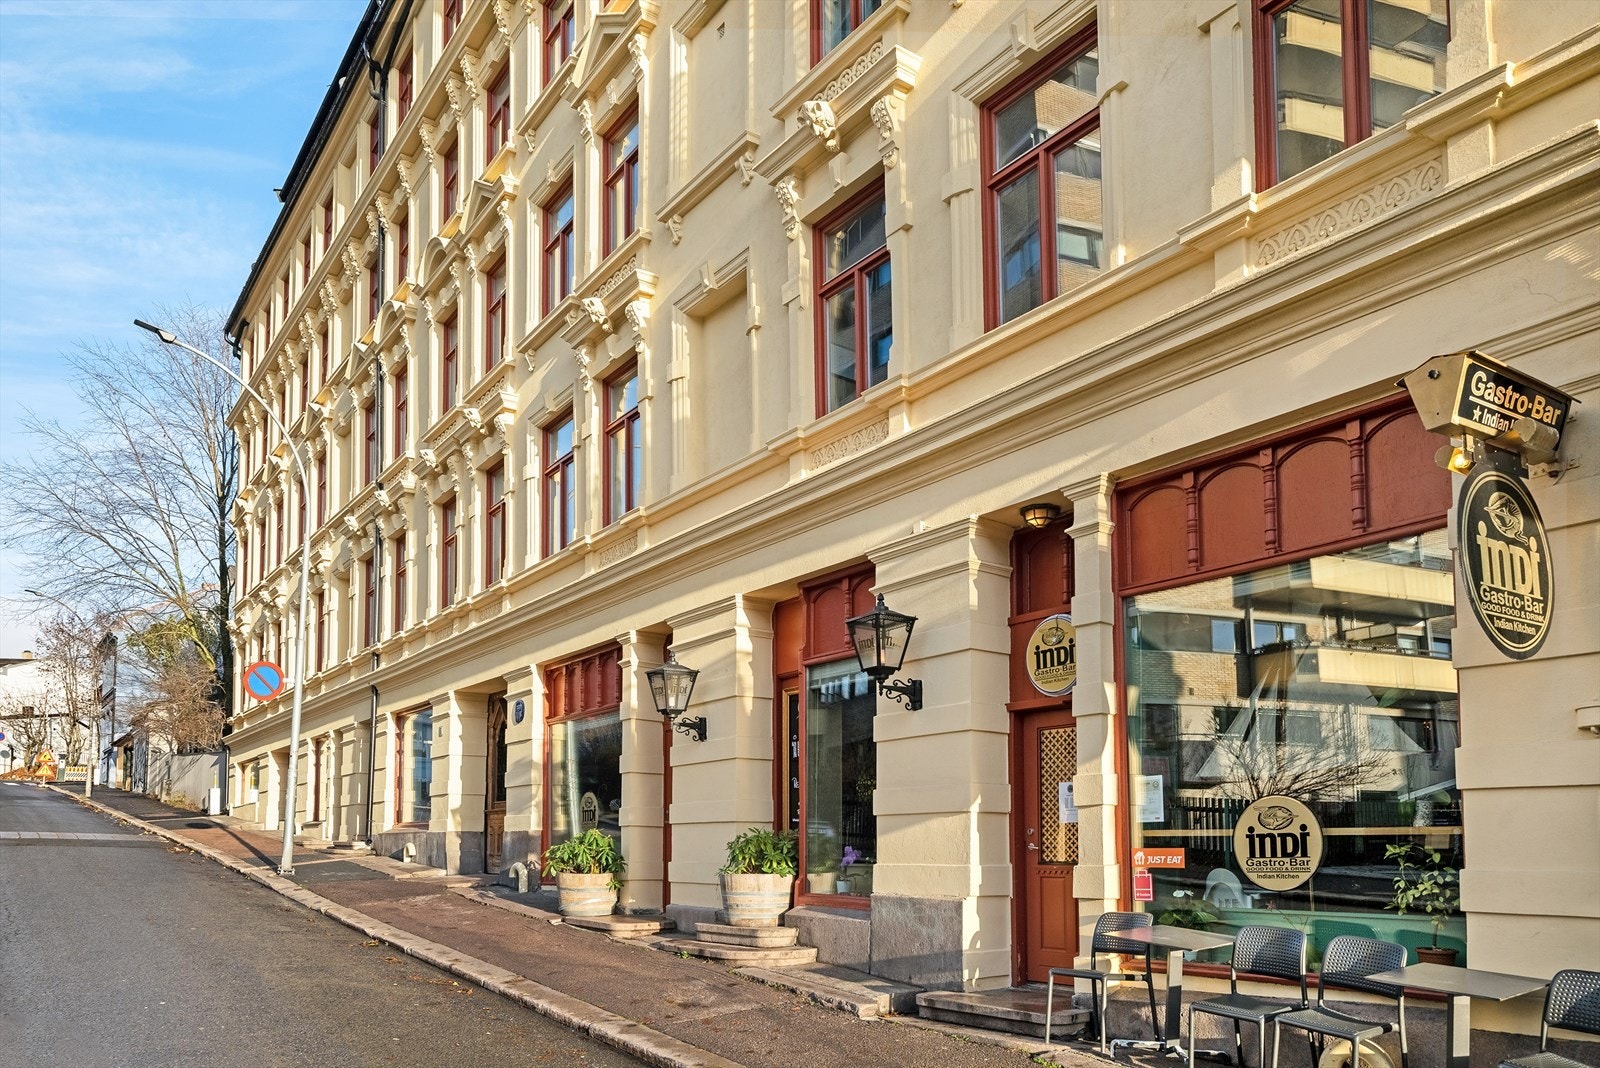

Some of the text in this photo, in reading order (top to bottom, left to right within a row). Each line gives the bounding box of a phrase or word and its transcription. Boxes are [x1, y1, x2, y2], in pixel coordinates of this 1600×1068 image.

[1482, 408, 1509, 431] Indian
[1481, 601, 1501, 613] GOOD
[1502, 606, 1520, 617] FOOD
[1526, 612, 1545, 623] DRINK
[1493, 616, 1536, 635] Indian Kitchen
[1147, 856, 1182, 864] JUST EAT
